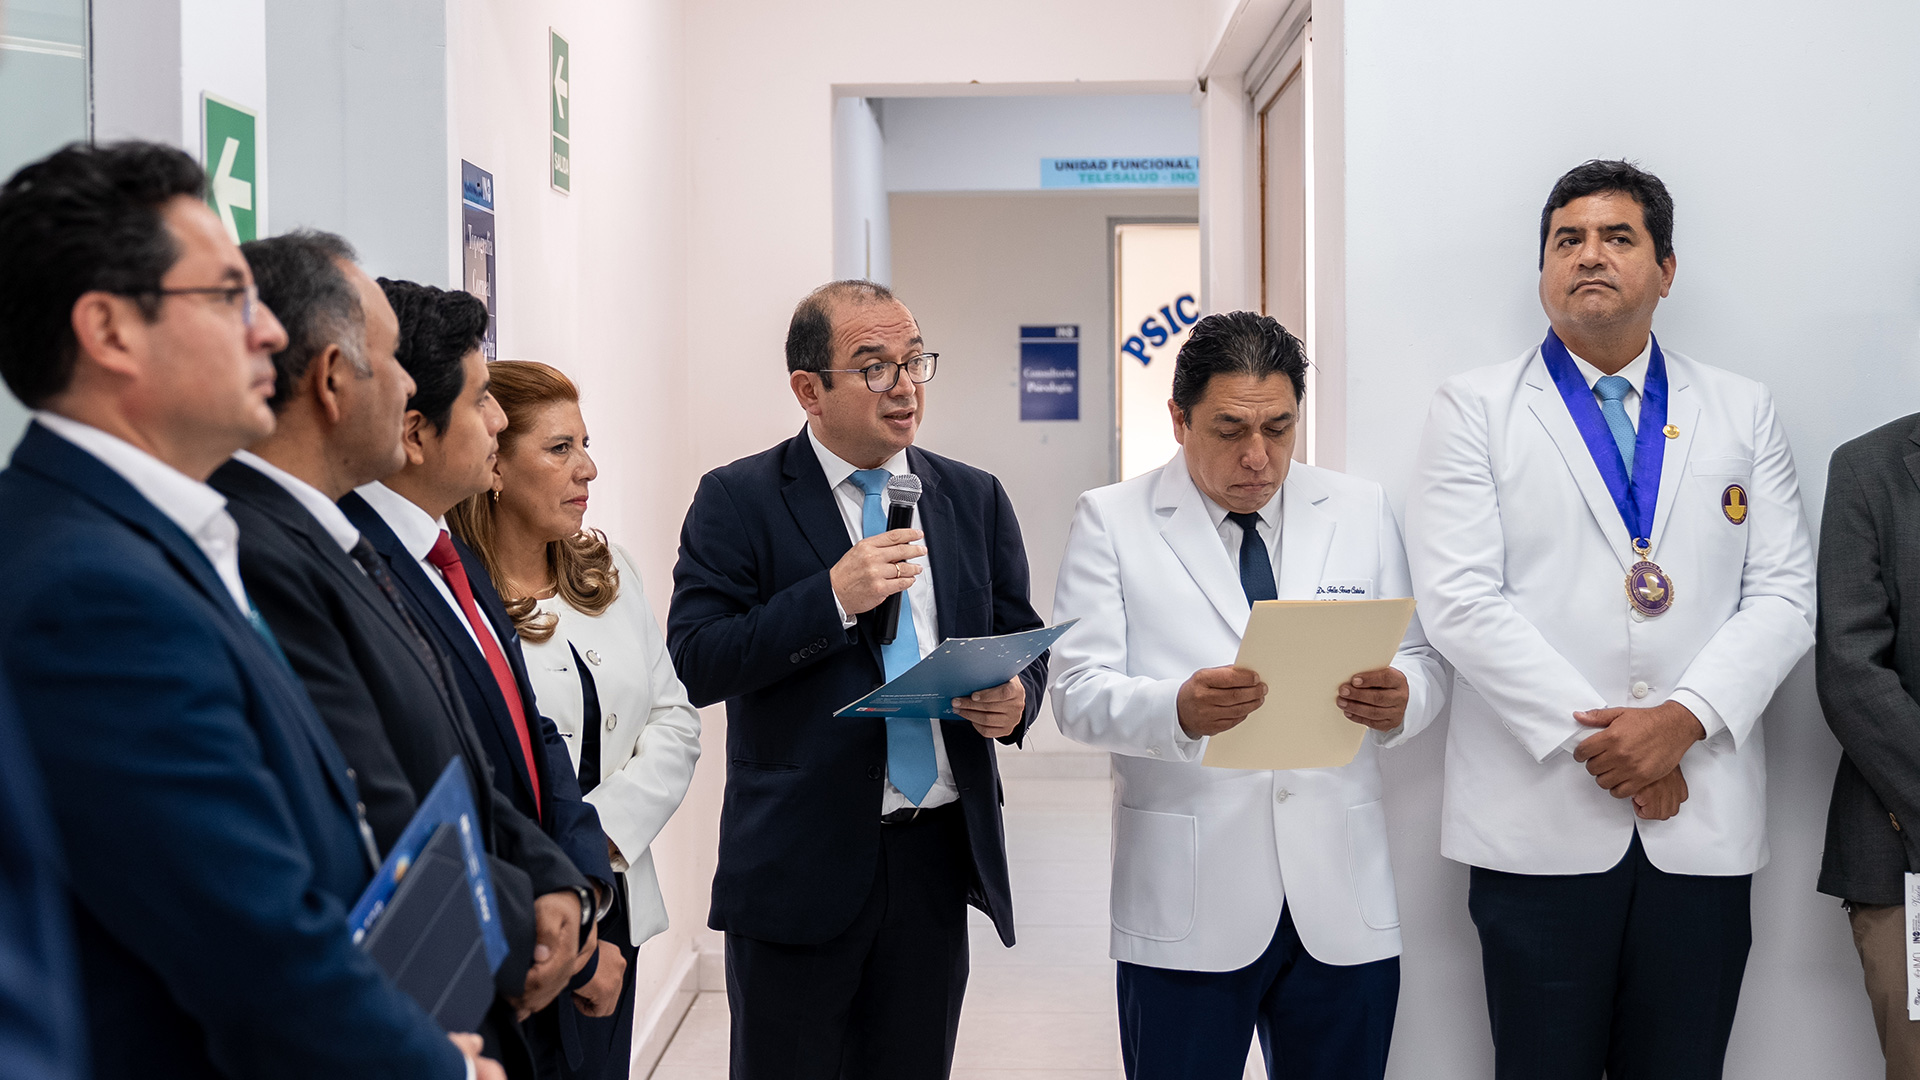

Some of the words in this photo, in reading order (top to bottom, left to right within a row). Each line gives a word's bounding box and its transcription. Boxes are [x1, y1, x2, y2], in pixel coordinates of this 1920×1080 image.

[555, 151, 570, 177] SALIDA
[1054, 159, 1108, 172] UNIDAD
[1112, 157, 1192, 171] FUNCIONAL
[1078, 171, 1159, 184] TELESALUD
[1170, 171, 1197, 183] INO
